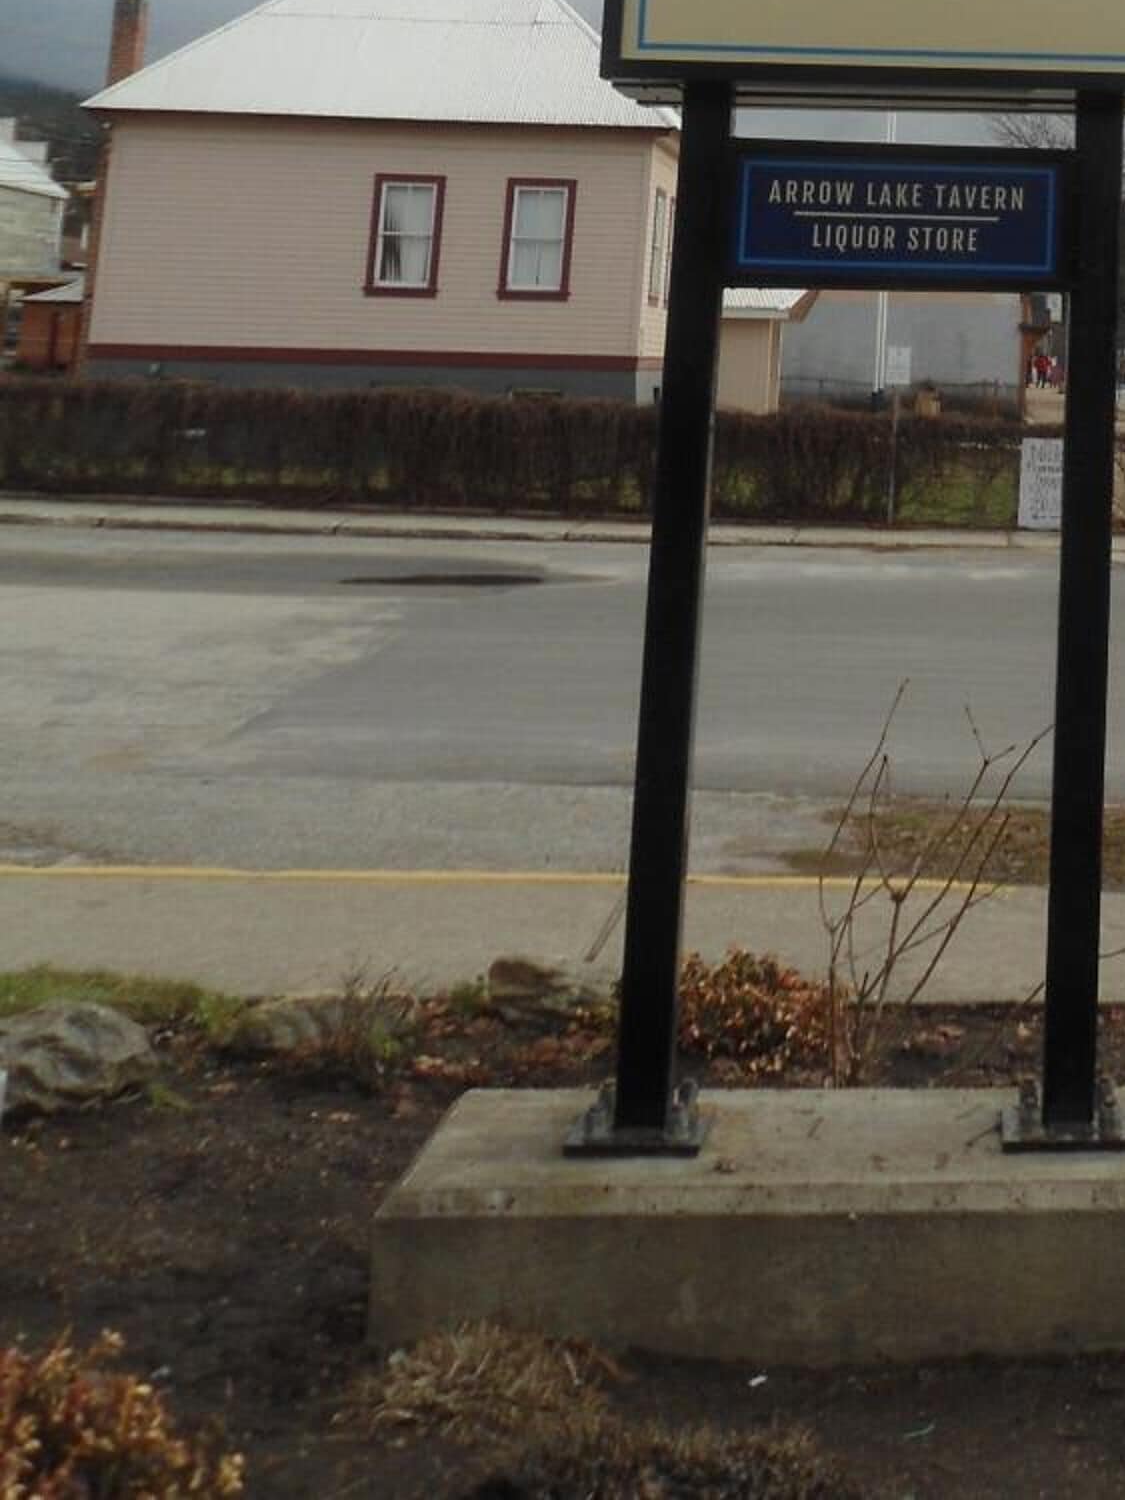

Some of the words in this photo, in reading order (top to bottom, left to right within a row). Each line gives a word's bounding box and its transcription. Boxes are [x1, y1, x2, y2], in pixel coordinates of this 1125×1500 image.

[769, 179, 854, 205] ARROW
[866, 182, 923, 207] LAKE
[935, 184, 1024, 211] TAVERN
[812, 223, 896, 252] LIQUOR
[907, 226, 978, 251] STORE
